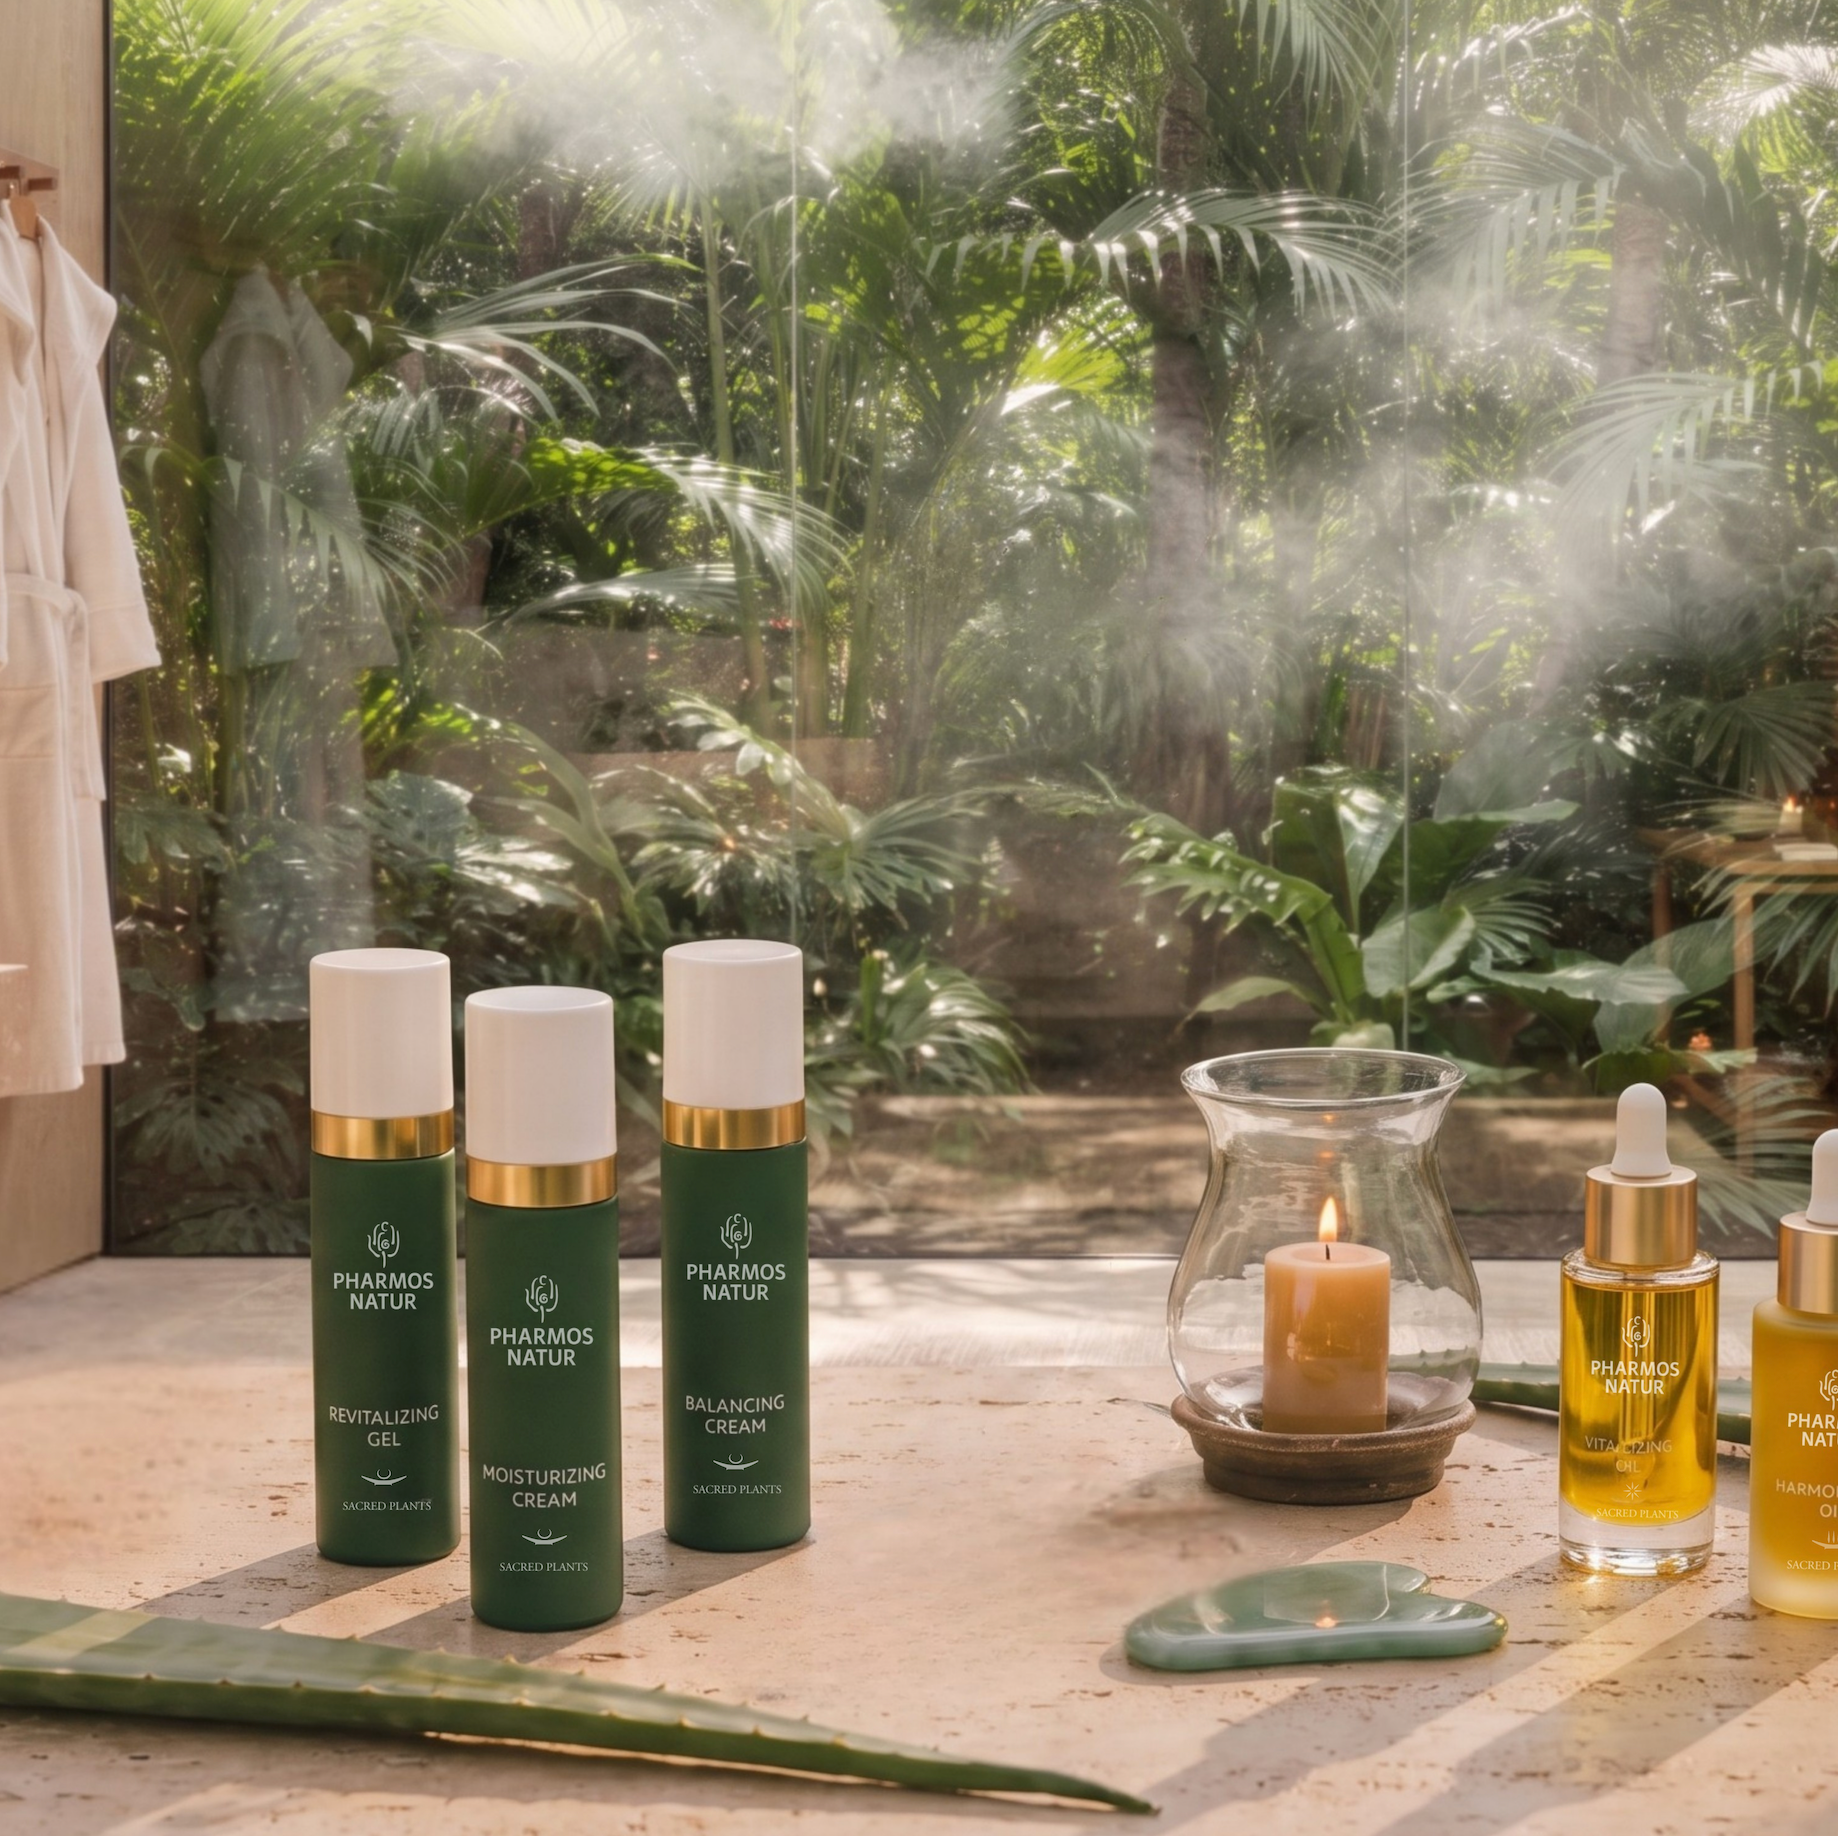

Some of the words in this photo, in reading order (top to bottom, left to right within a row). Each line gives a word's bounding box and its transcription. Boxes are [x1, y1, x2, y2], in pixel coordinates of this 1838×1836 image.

[686, 1263, 786, 1281] PHARMOS
[333, 1272, 434, 1291] PHARMOS
[350, 1292, 417, 1310] NATUR
[703, 1283, 769, 1301] NATUR
[490, 1327, 594, 1346] PHARMOS
[507, 1348, 576, 1367] NATUR
[1590, 1359, 1680, 1377] PHARMOS
[1605, 1378, 1664, 1395] NATUR
[685, 1394, 785, 1414] BALANCING
[329, 1404, 439, 1426] REVITALIZING
[1787, 1412, 1838, 1430] PHAR
[704, 1418, 766, 1435] CREAM
[367, 1431, 401, 1448] GEL
[1801, 1431, 1838, 1448] NAT
[482, 1462, 606, 1486] MOISTURIZING
[692, 1484, 737, 1495] SACRED
[739, 1484, 782, 1495] PLANTS
[1775, 1478, 1838, 1499] HARMO
[342, 1501, 387, 1512] SACRED
[389, 1500, 432, 1512] PLANTS
[512, 1491, 577, 1509] CREAM
[1595, 1508, 1638, 1519] SACRED
[1640, 1509, 1679, 1520] PLANTS
[499, 1562, 544, 1573] SACRED
[546, 1562, 589, 1573] PLANTS
[1786, 1560, 1831, 1571] SACRED
